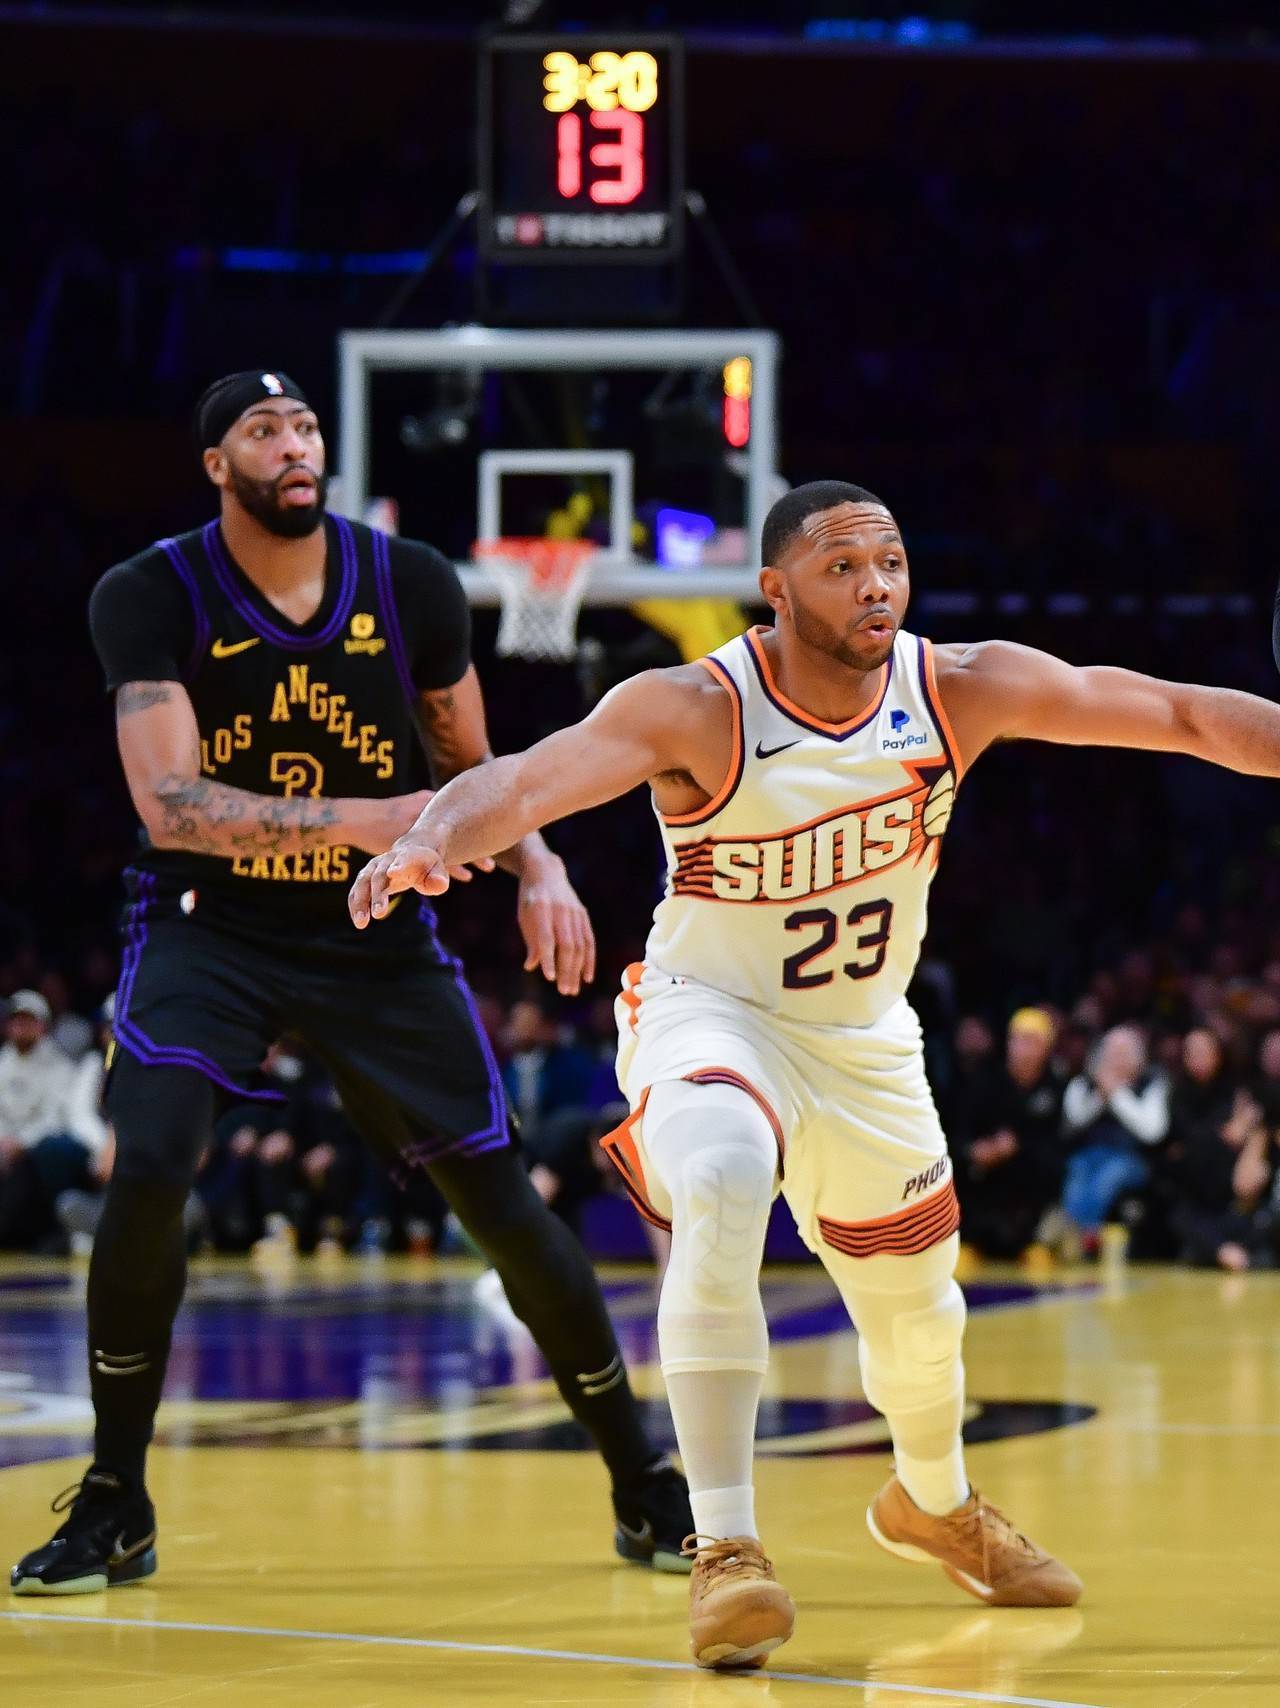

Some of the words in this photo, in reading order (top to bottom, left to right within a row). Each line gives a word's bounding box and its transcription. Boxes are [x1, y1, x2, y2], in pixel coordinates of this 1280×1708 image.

[542, 51, 658, 112] 3:20
[557, 108, 644, 205] 13
[200, 714, 252, 774] LOS
[269, 664, 394, 779] ANGELES
[882, 731, 928, 751] PayPal
[711, 797, 914, 901] SUNS
[782, 897, 894, 989] 23
